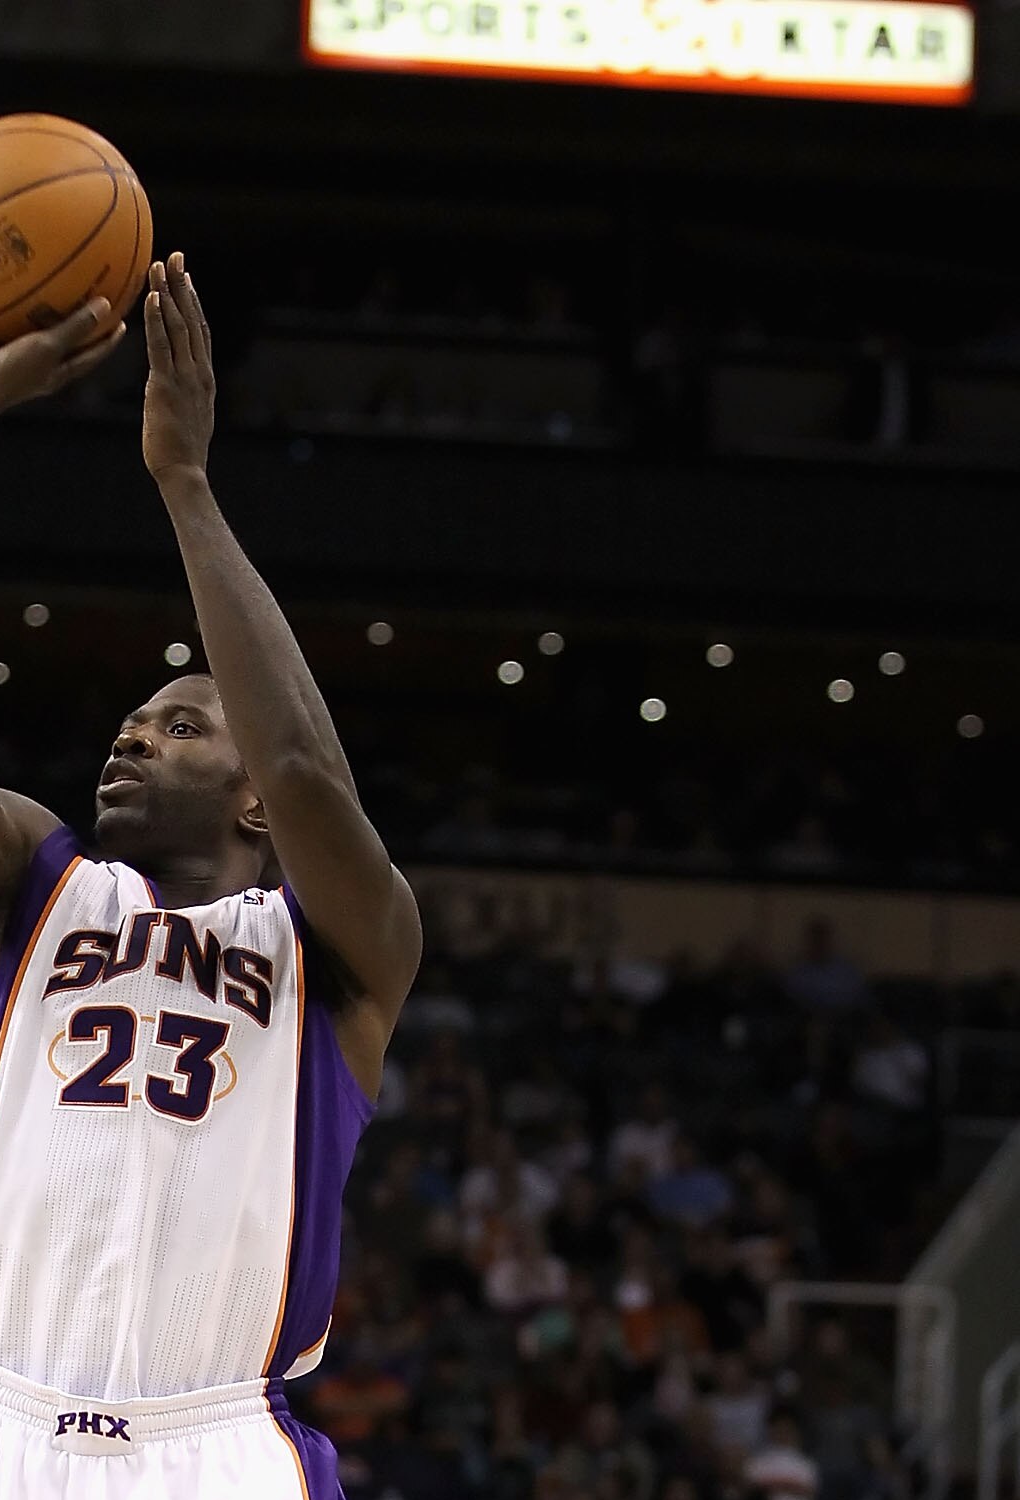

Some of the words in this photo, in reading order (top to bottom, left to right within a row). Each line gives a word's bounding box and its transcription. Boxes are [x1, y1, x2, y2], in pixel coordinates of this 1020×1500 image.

[42, 909, 274, 1029] SUNS
[55, 1003, 231, 1125] 23
[55, 1411, 132, 1442] PHX
